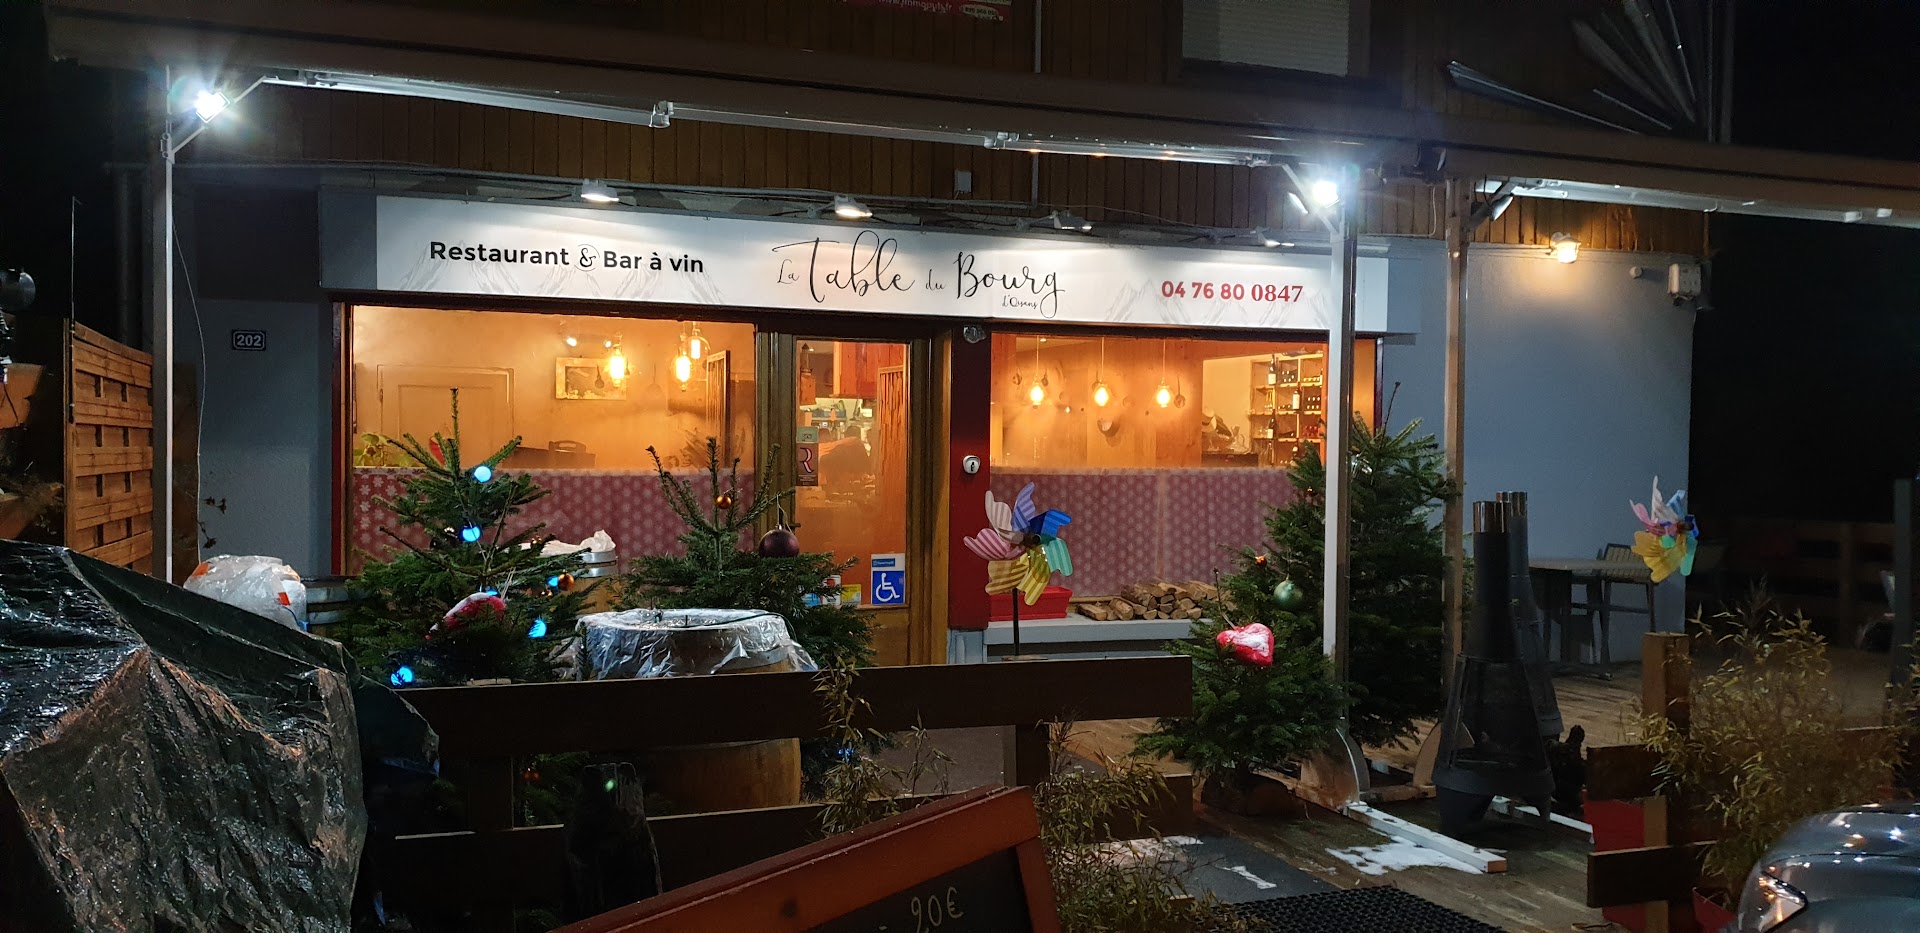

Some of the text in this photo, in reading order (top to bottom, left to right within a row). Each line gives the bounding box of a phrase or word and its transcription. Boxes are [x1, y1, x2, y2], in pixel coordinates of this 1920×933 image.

[429, 241, 704, 273] Restaurant & Bar à vin
[772, 230, 1065, 318] La Table du Bourg
[1161, 281, 1304, 303] 04 76 80 0847
[237, 335, 261, 346] 202
